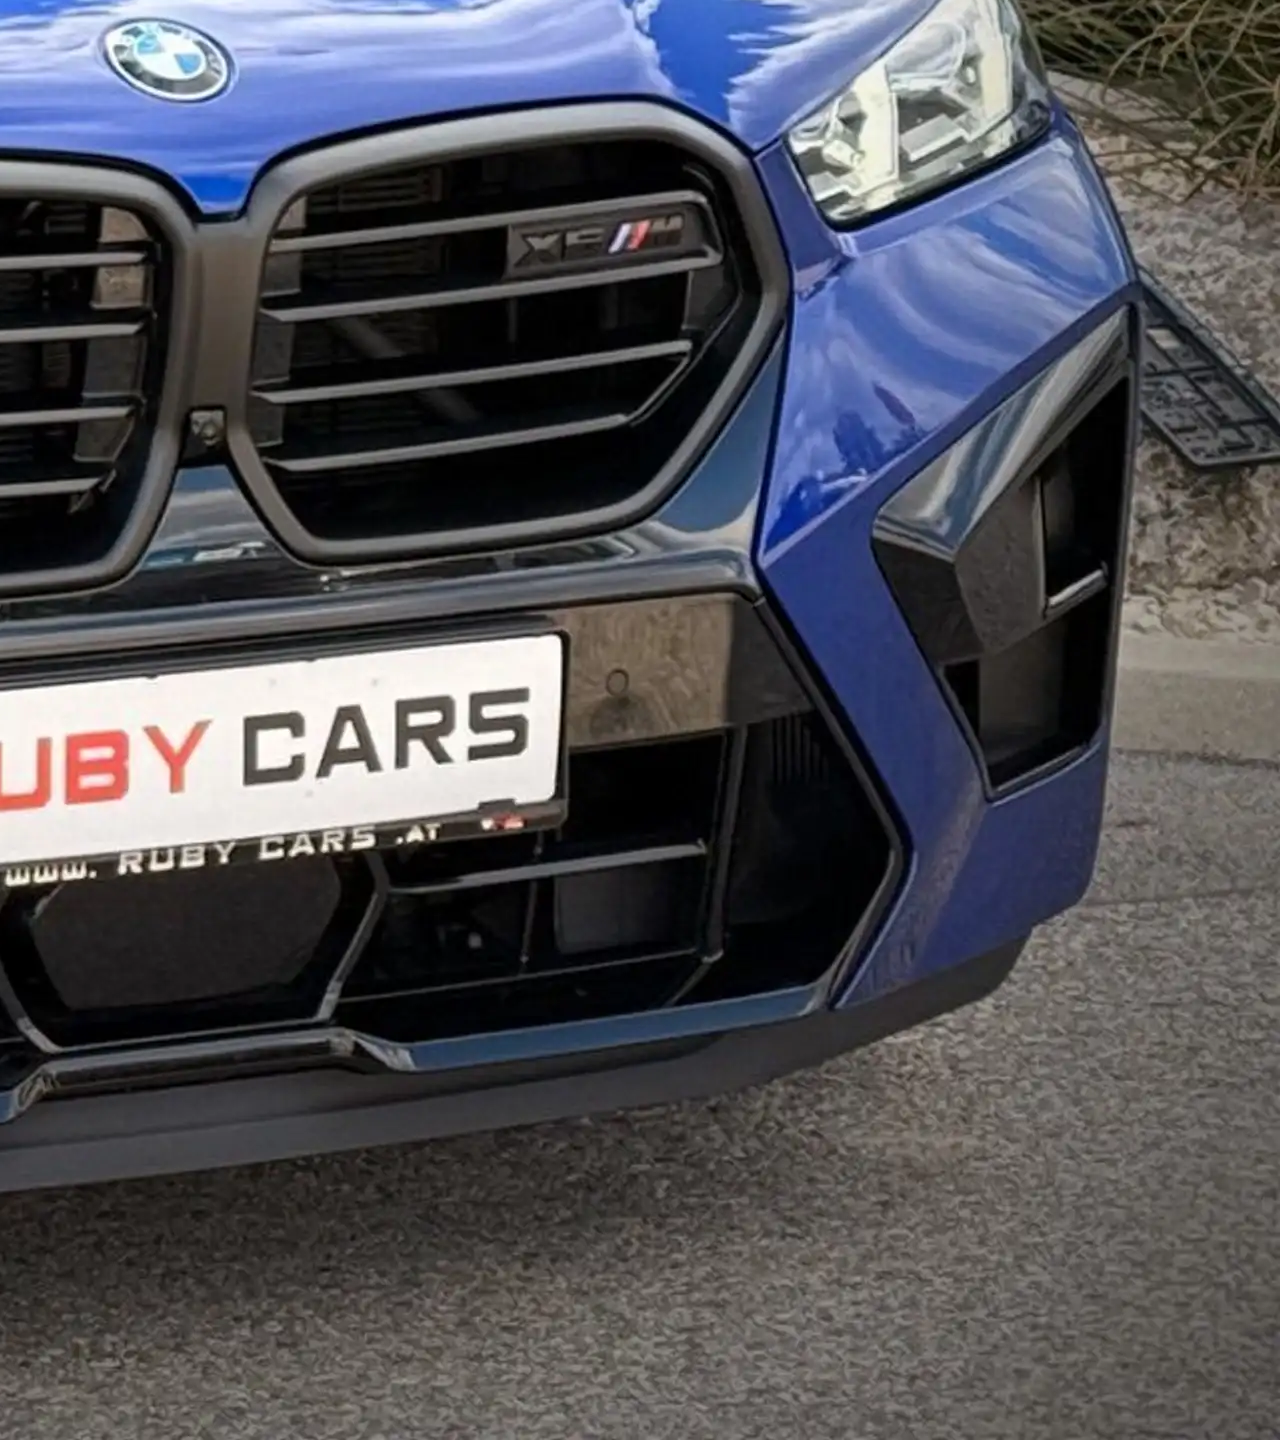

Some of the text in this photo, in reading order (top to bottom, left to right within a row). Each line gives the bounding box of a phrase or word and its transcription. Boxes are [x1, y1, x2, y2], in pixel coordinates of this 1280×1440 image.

[242, 687, 531, 787] CARS
[117, 841, 236, 876] RUBY
[257, 825, 377, 861] CARS
